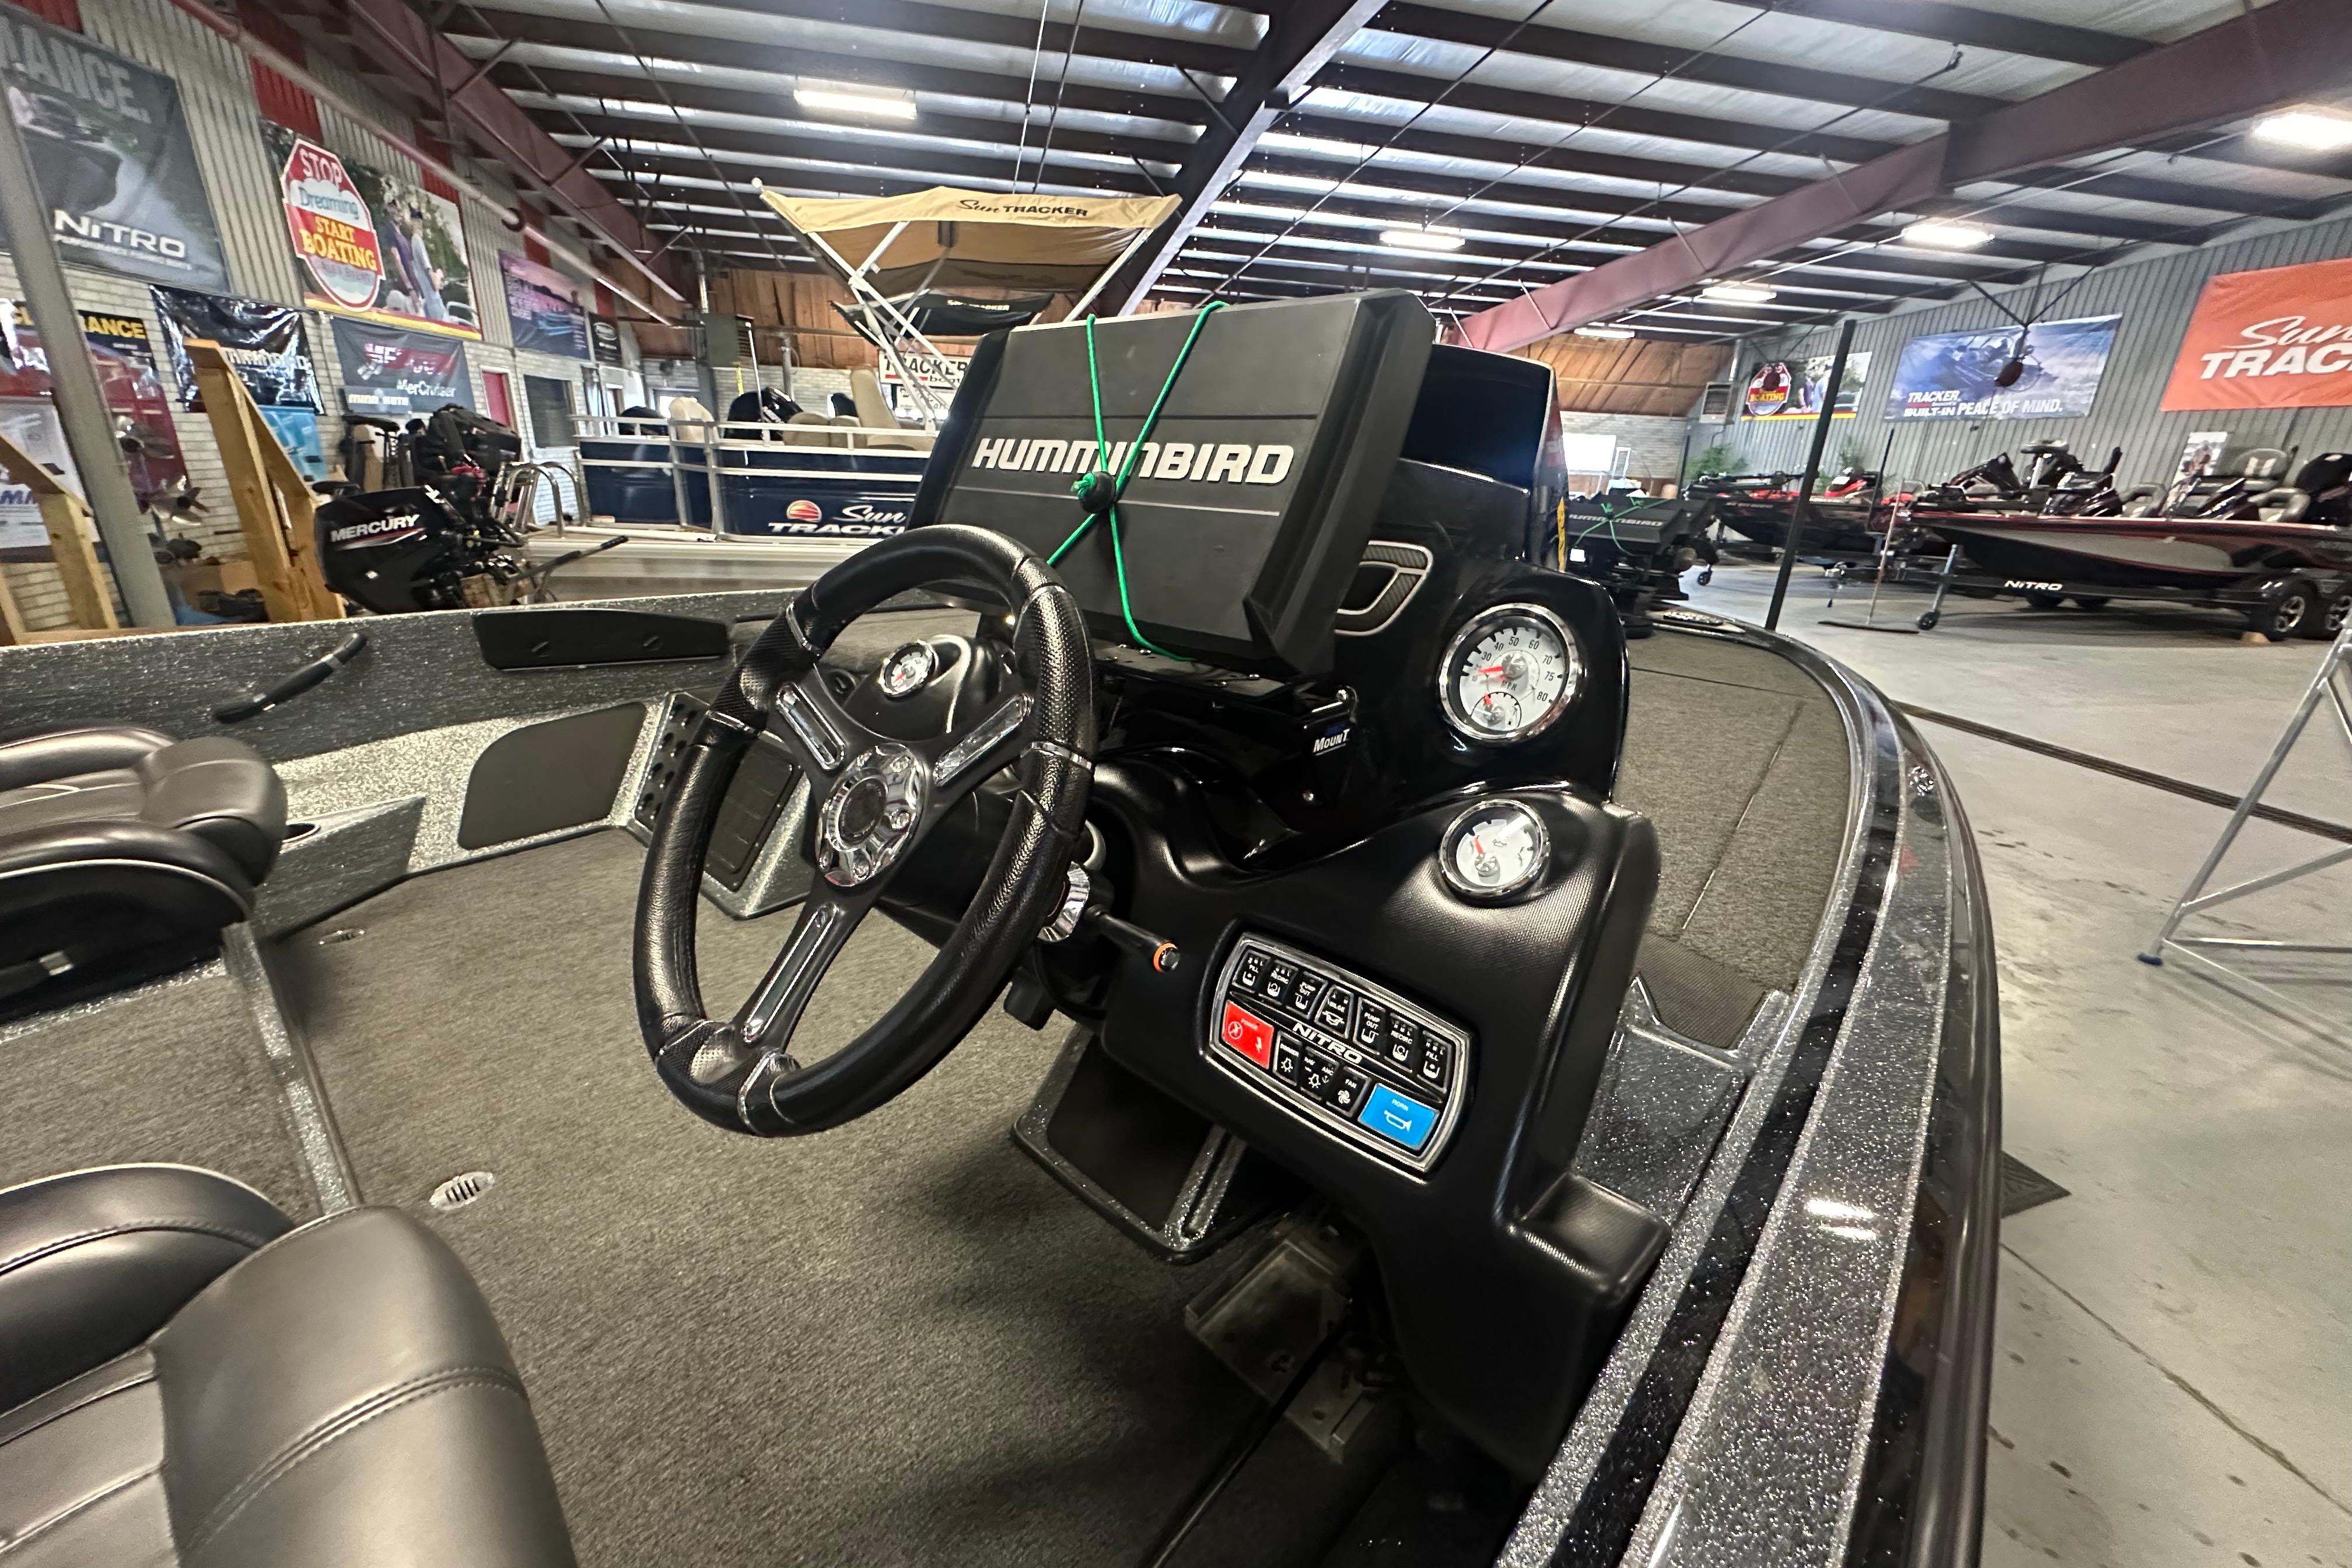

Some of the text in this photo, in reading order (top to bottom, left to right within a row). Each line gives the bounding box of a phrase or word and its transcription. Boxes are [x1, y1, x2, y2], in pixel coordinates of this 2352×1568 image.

[299, 148, 343, 188] STOP
[299, 187, 359, 219] Dreaming
[956, 200, 1088, 216] Sun TRACKER
[54, 209, 186, 258] NITRO
[315, 216, 355, 243] START
[299, 229, 377, 271] BOATING
[2200, 342, 2352, 379] TRAC
[1908, 390, 1960, 402] TRACKER
[1903, 407, 1956, 416] BUILT-IN
[1957, 400, 1999, 415] PEACE
[2001, 400, 2018, 414] OF
[2022, 398, 2063, 413] MIND.
[972, 438, 1294, 484] HUMMINBIRD
[832, 505, 906, 523] Sun
[331, 514, 420, 542] MERCURY
[2004, 580, 2063, 590] NITRO
[1494, 642, 1504, 651] 40
[1508, 636, 1519, 646] 50
[1528, 640, 1539, 649] 60
[1481, 652, 1492, 662] 30
[1543, 654, 1552, 665] 70
[1545, 671, 1555, 681] 75
[1537, 691, 1548, 702] 80
[1364, 1012, 1380, 1023] PUMP
[1366, 1021, 1378, 1030] OUT
[1293, 1022, 1363, 1064] NITRO
[1391, 1030, 1413, 1044] RECIRC
[1426, 1051, 1438, 1061] FILL
[1345, 1079, 1357, 1089] FAN
[1391, 1098, 1409, 1111] HORN
